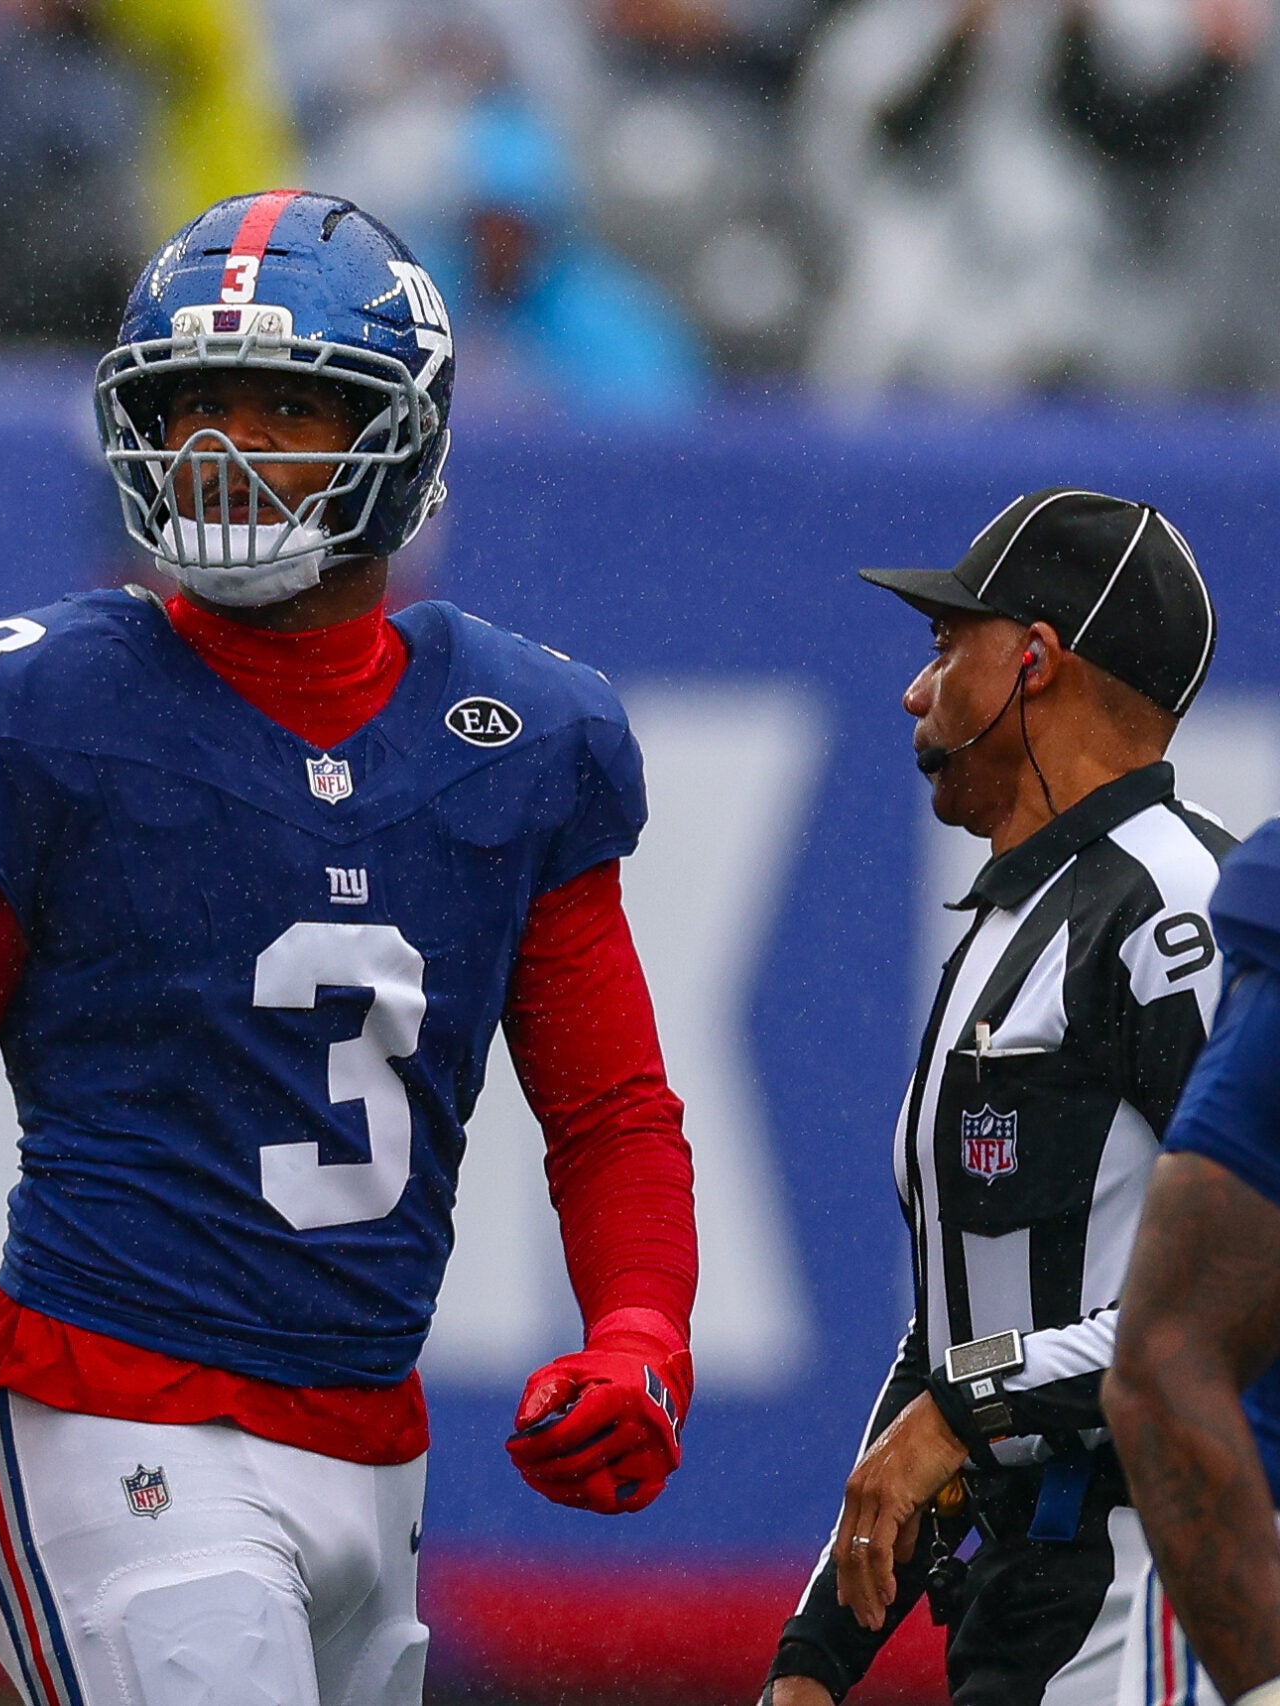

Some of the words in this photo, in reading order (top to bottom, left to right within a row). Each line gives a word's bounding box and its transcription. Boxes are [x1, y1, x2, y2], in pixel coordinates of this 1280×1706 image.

[221, 255, 260, 304] 3
[459, 708, 511, 735] EA
[316, 775, 346, 794] NFL
[1153, 912, 1216, 984] 9
[253, 922, 426, 1230] 3
[967, 1139, 1011, 1173] NFL
[133, 1486, 166, 1509] NFL
